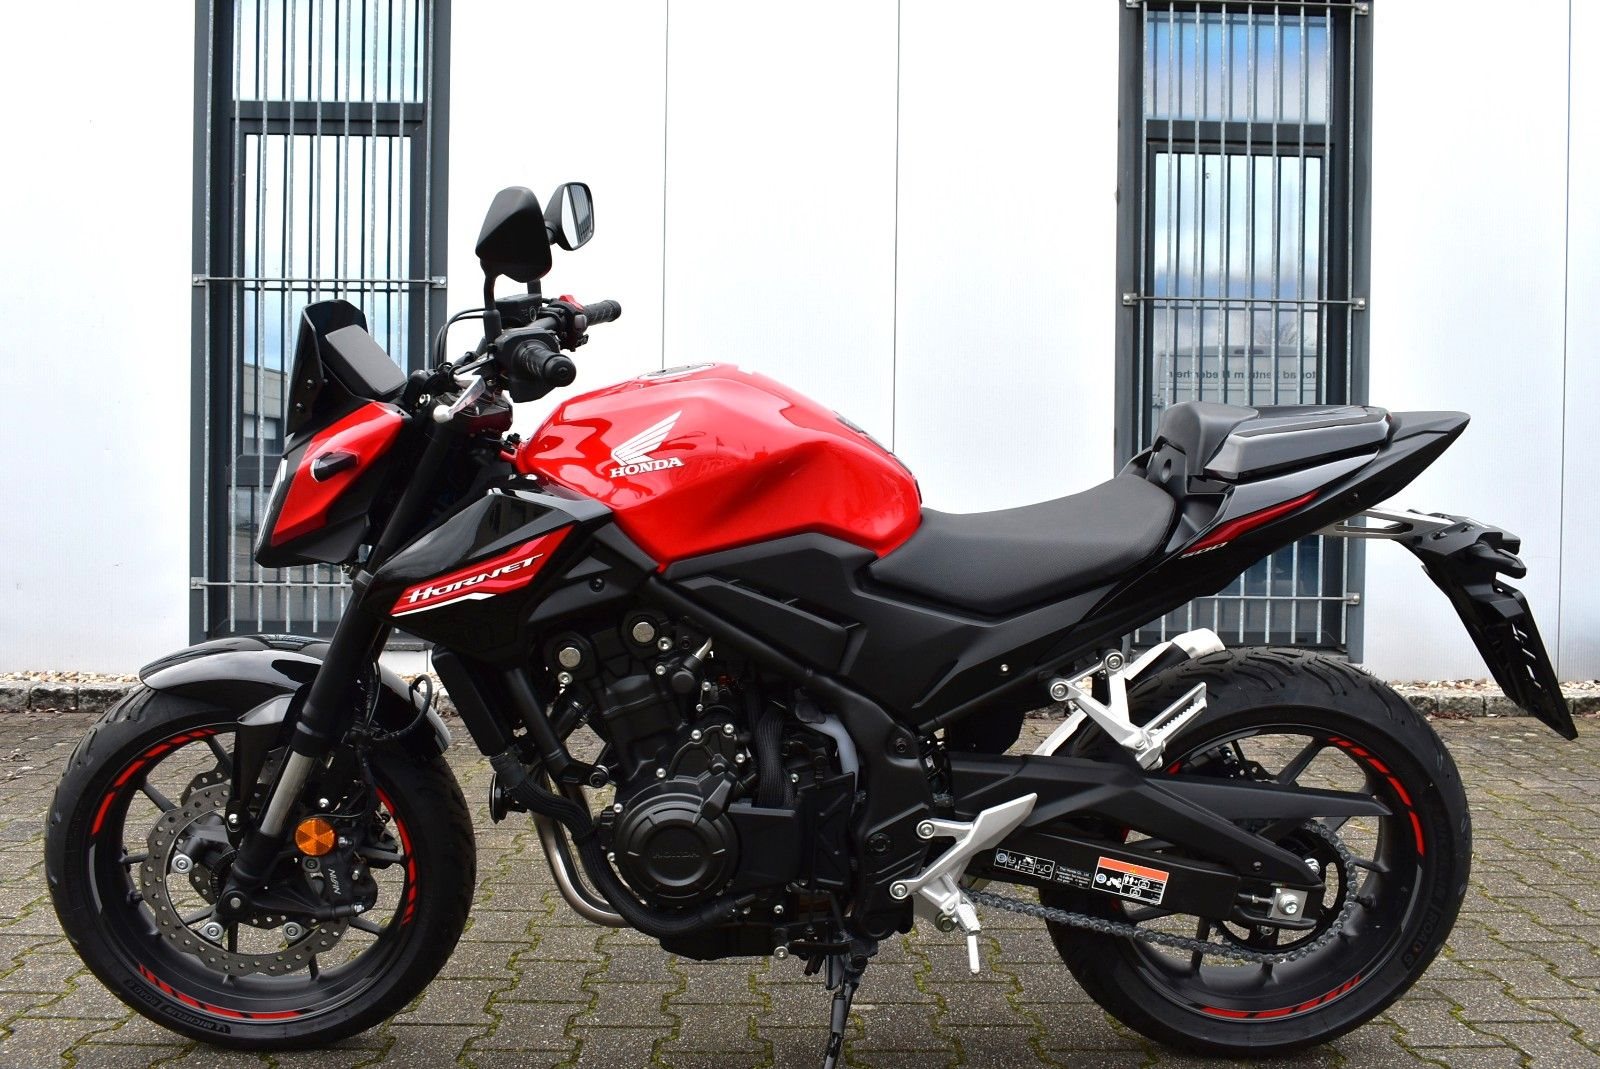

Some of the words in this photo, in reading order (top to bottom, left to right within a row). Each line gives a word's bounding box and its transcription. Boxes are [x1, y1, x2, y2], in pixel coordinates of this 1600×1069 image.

[610, 457, 685, 478] HONDA
[402, 553, 543, 603] HORNET
[164, 1007, 214, 1030] MICHELIN
